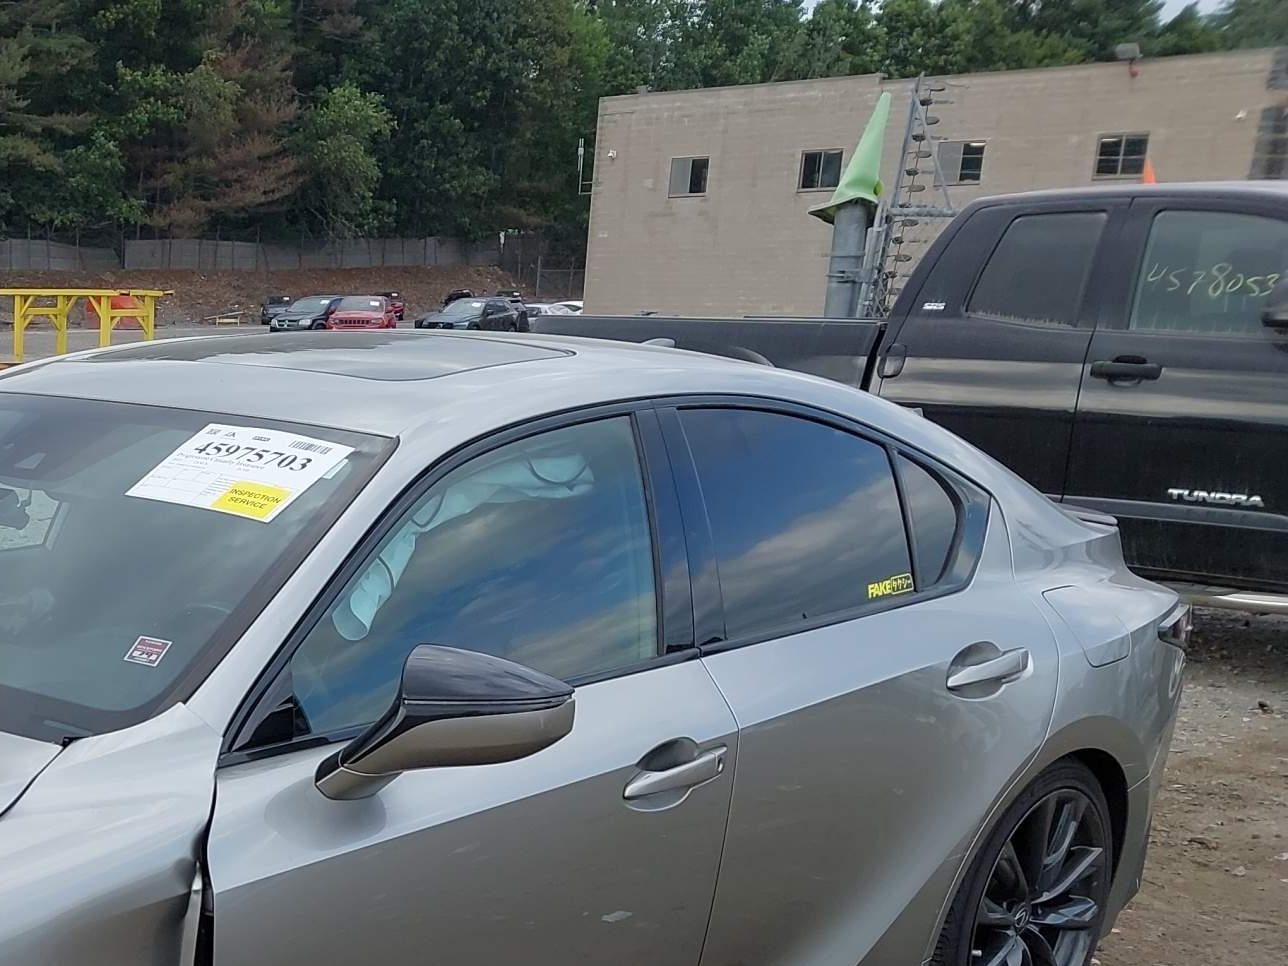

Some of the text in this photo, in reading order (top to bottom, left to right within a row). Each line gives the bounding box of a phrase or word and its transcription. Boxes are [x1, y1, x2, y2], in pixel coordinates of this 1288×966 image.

[193, 441, 313, 472] 45975703
[227, 496, 268, 510] SERVICE
[230, 487, 282, 505] INSPECTION
[1167, 487, 1265, 508] TUNDRA
[867, 580, 892, 599] FAKE
